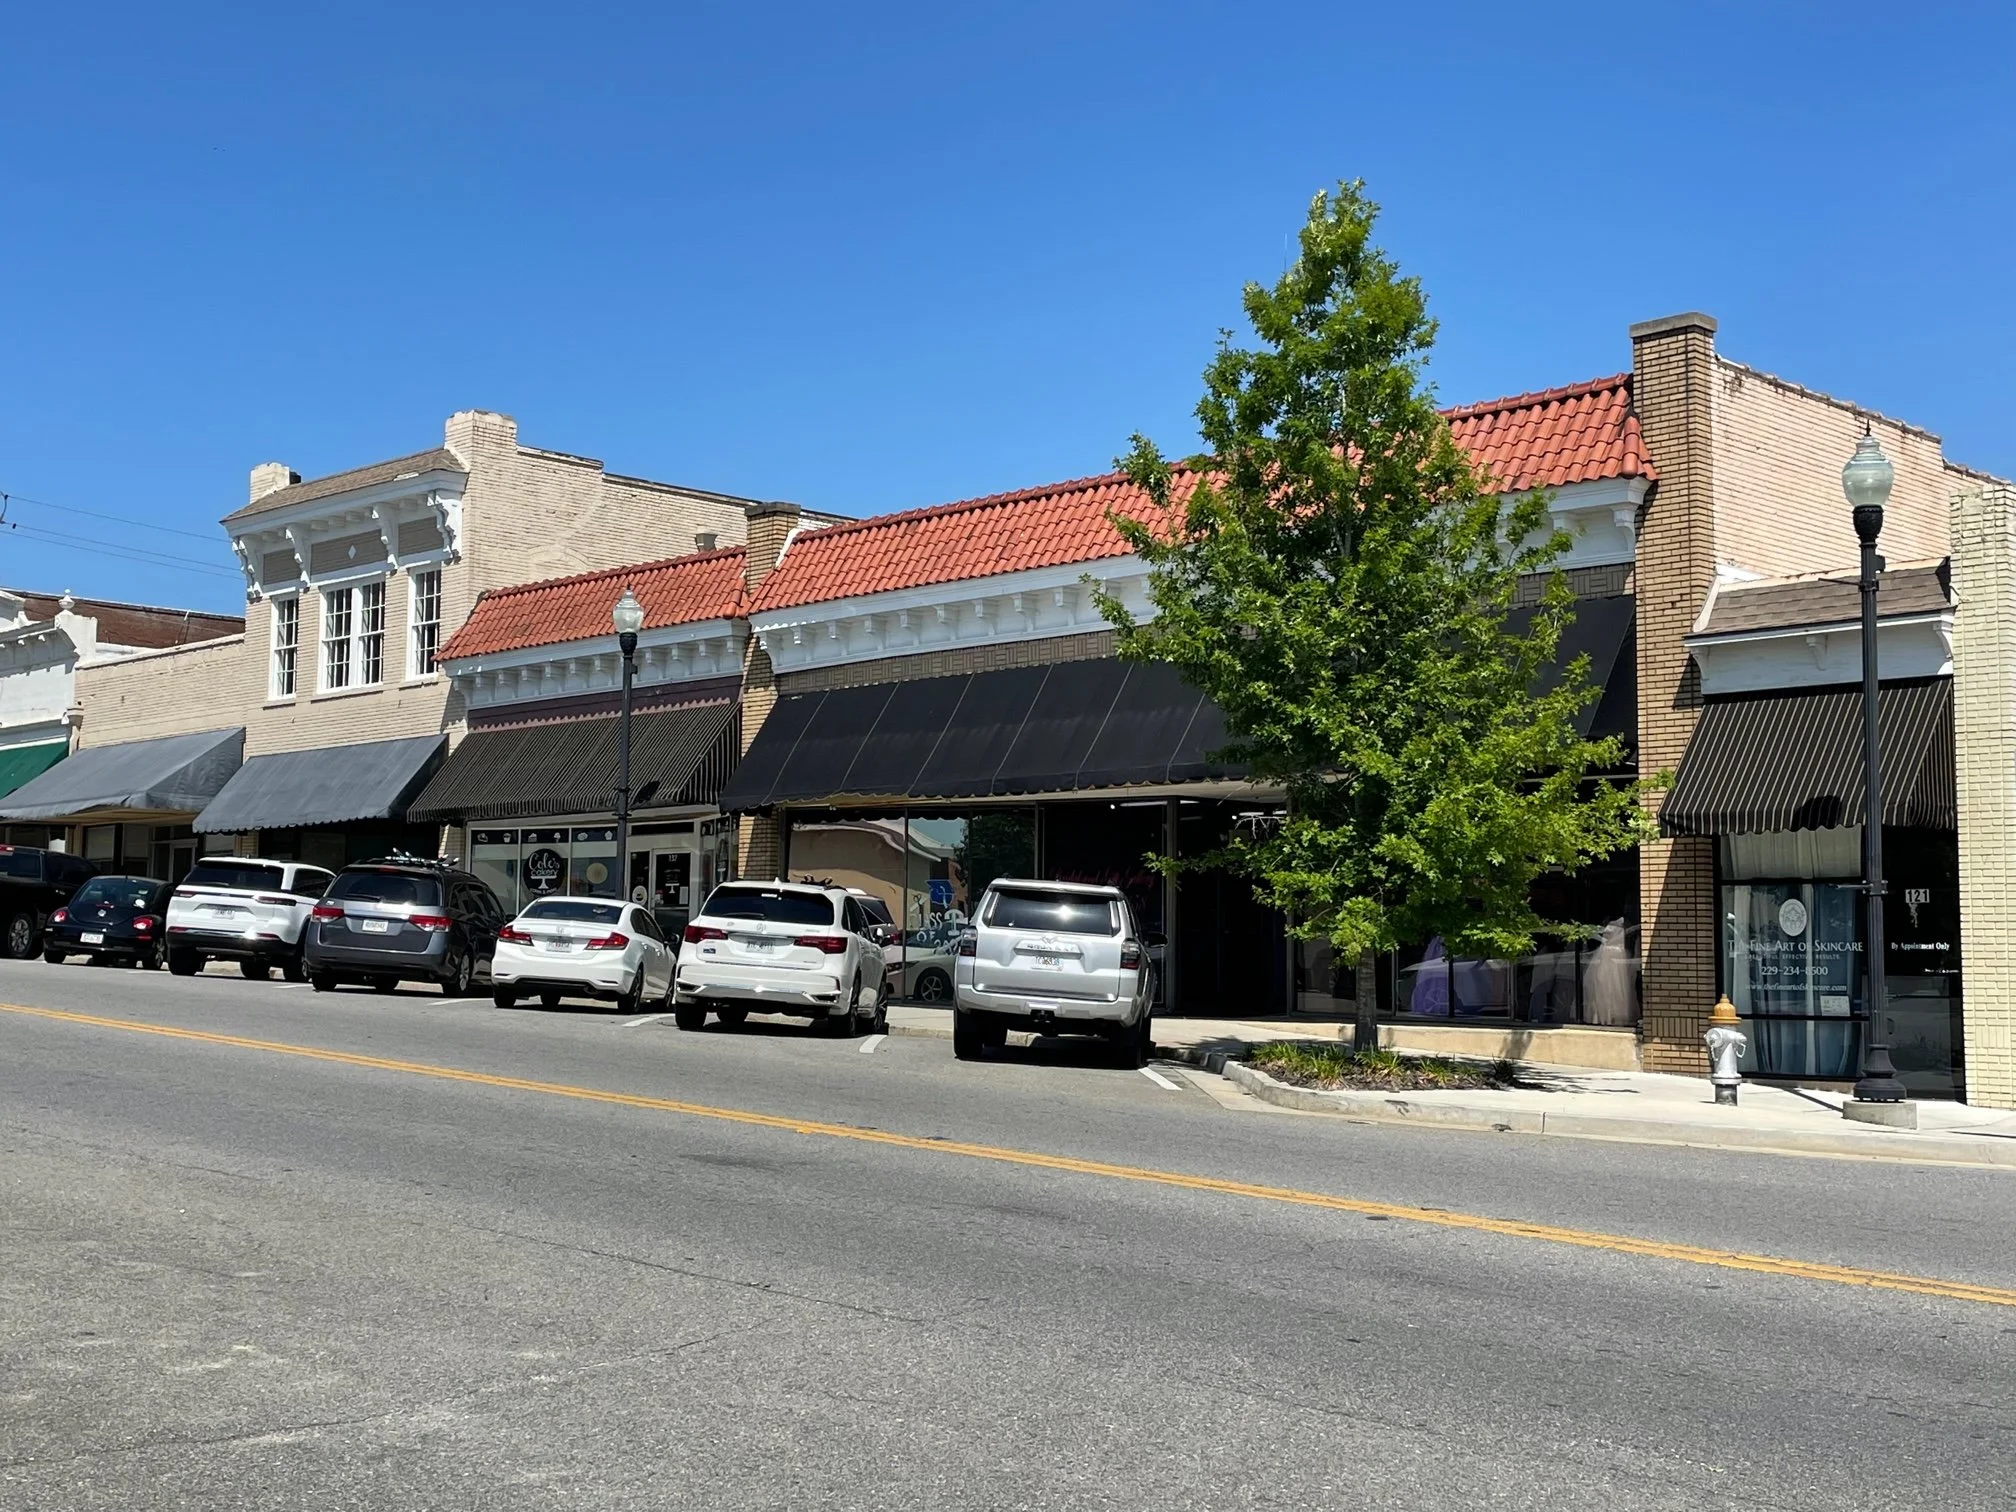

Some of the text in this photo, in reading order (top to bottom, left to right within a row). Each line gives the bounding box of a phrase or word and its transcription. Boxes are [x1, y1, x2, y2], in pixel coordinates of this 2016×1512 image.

[528, 852, 560, 870] Cole's
[1907, 889, 1928, 902] 121
[917, 931, 936, 942] OF
[1775, 940, 1796, 952] ART
[1814, 940, 1864, 952] SKINCARE
[1901, 942, 1935, 951] Appointment
[1935, 942, 1950, 951] Only
